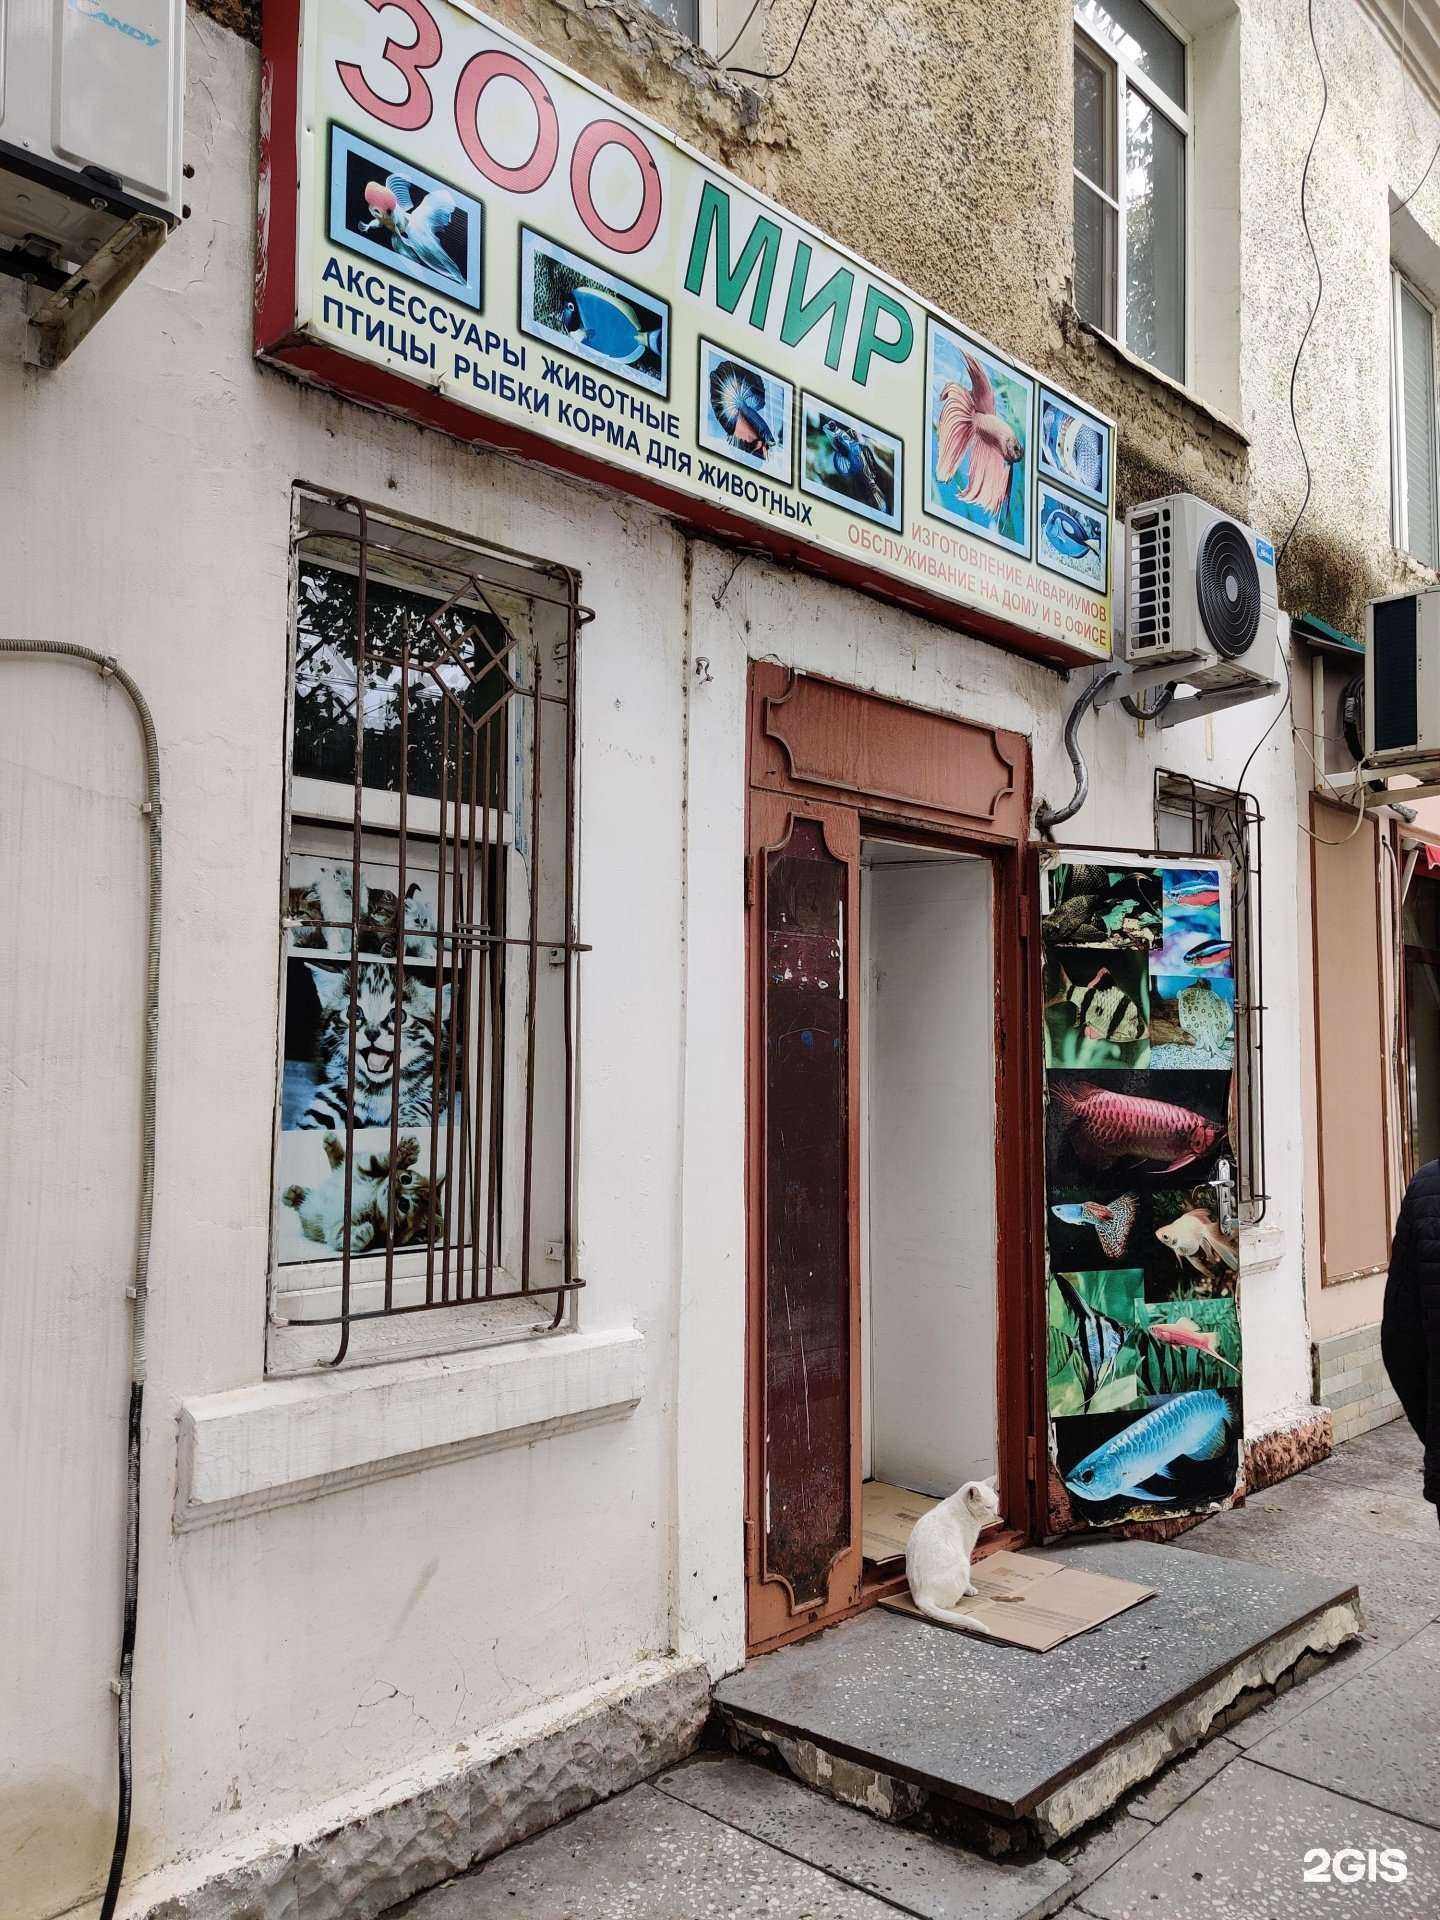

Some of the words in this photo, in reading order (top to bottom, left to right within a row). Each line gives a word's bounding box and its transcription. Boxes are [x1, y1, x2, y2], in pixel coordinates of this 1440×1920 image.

[321, 256, 527, 371] АКСЕССУАРЫ
[541, 355, 680, 439] ЖИВОТНЫЕ
[684, 180, 914, 386] МИР
[323, 295, 436, 369] ПТИЦЫ
[454, 353, 550, 418] РЫБКИ
[558, 399, 641, 455] КОРМА
[646, 440, 692, 477] ДЛЯ
[698, 458, 813, 526] ЖИВОТНЫХ
[847, 523, 976, 593] ОБСЛУЖИВАНИЕ
[979, 582, 999, 602] НА
[1001, 589, 1038, 618] ДОМУ
[1041, 605, 1051, 624] И
[1053, 608, 1062, 627] В
[1064, 616, 1107, 646] ОФИСЕ
[911, 522, 1023, 586] ИЗГОТОВЛЕНИЕ
[1025, 577, 1107, 622] АКВАРИУМОВ
